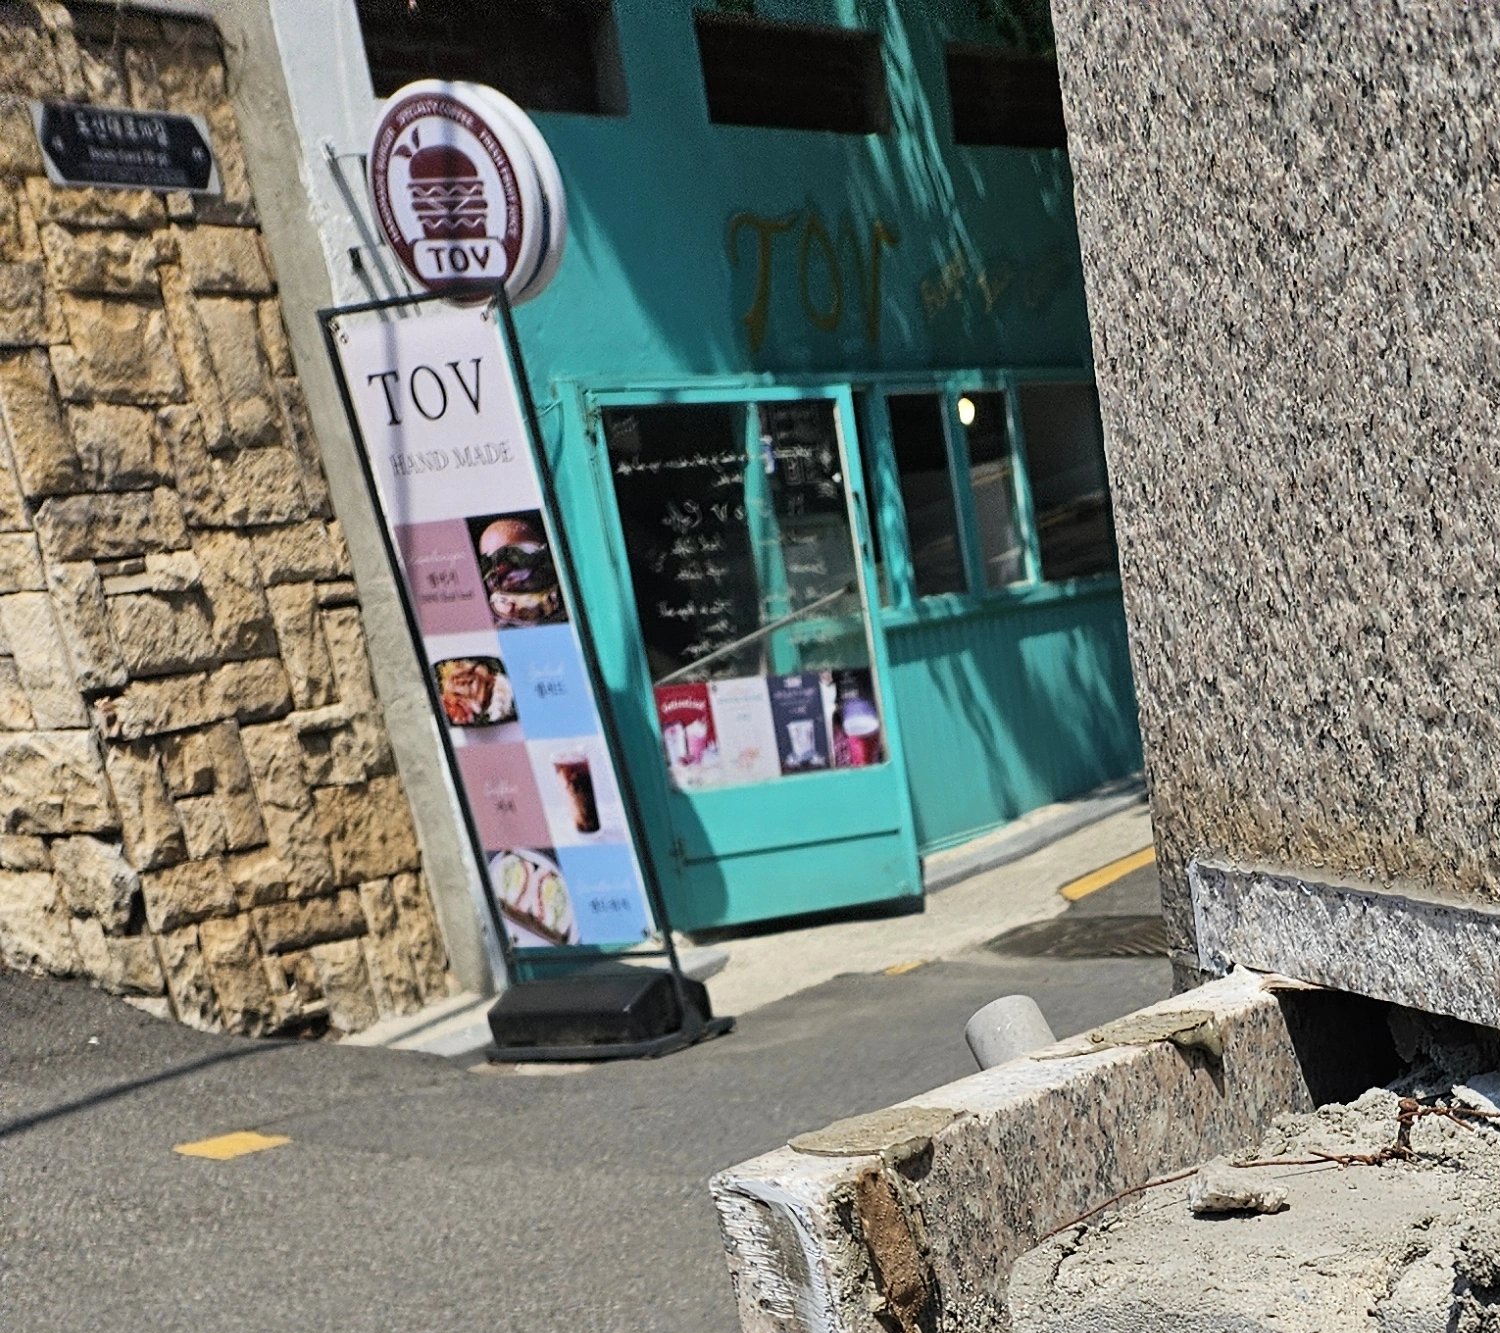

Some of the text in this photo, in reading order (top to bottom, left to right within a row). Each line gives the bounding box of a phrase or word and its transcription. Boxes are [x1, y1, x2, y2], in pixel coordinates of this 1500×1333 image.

[427, 246, 490, 273] TOV
[729, 209, 898, 354] TOV
[367, 358, 482, 426] TOV
[390, 441, 514, 476] HAND MADE
